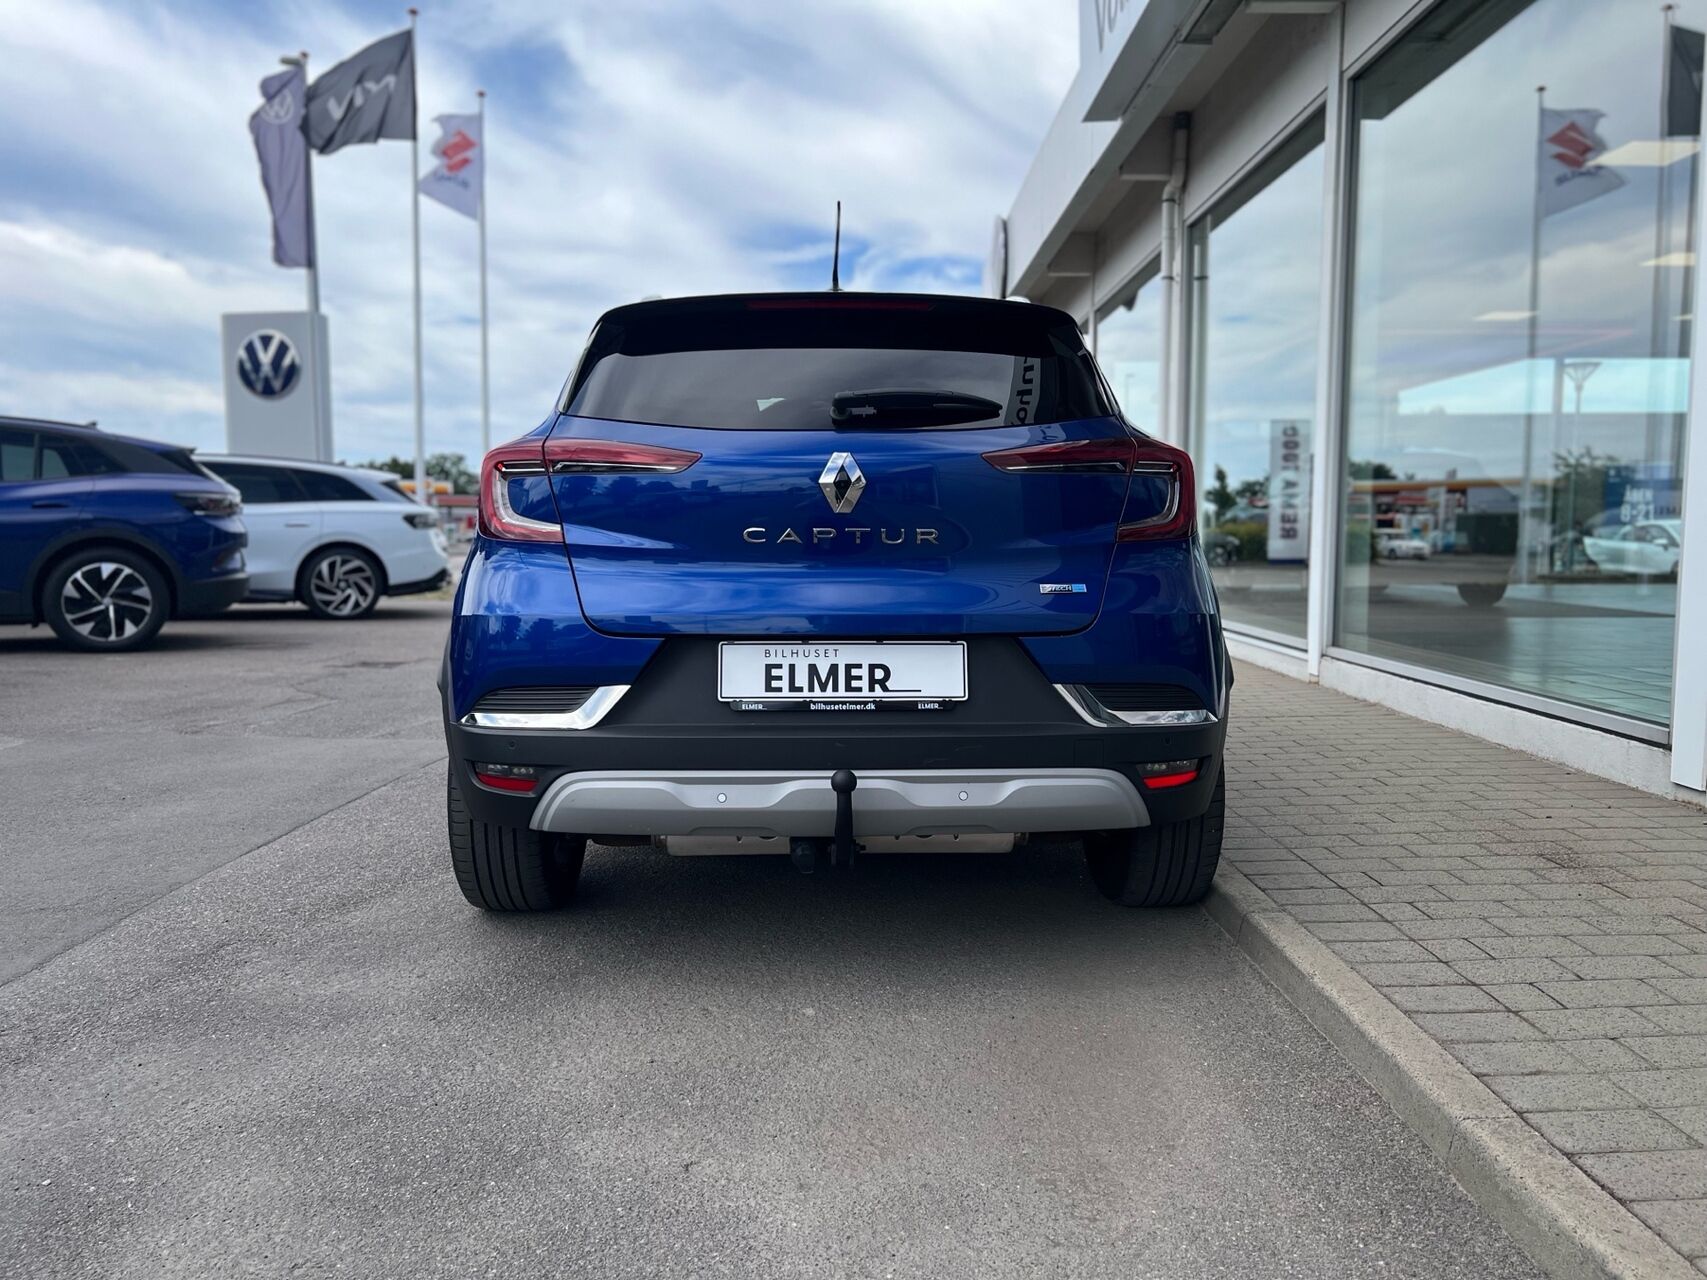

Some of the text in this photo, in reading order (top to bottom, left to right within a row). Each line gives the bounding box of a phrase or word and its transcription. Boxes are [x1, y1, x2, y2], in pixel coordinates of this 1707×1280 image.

[743, 527, 941, 545] CAPTUR
[764, 648, 840, 658] BILHUSET
[764, 663, 893, 693] ELMER
[809, 702, 876, 711] bilhusetelmer.dk
